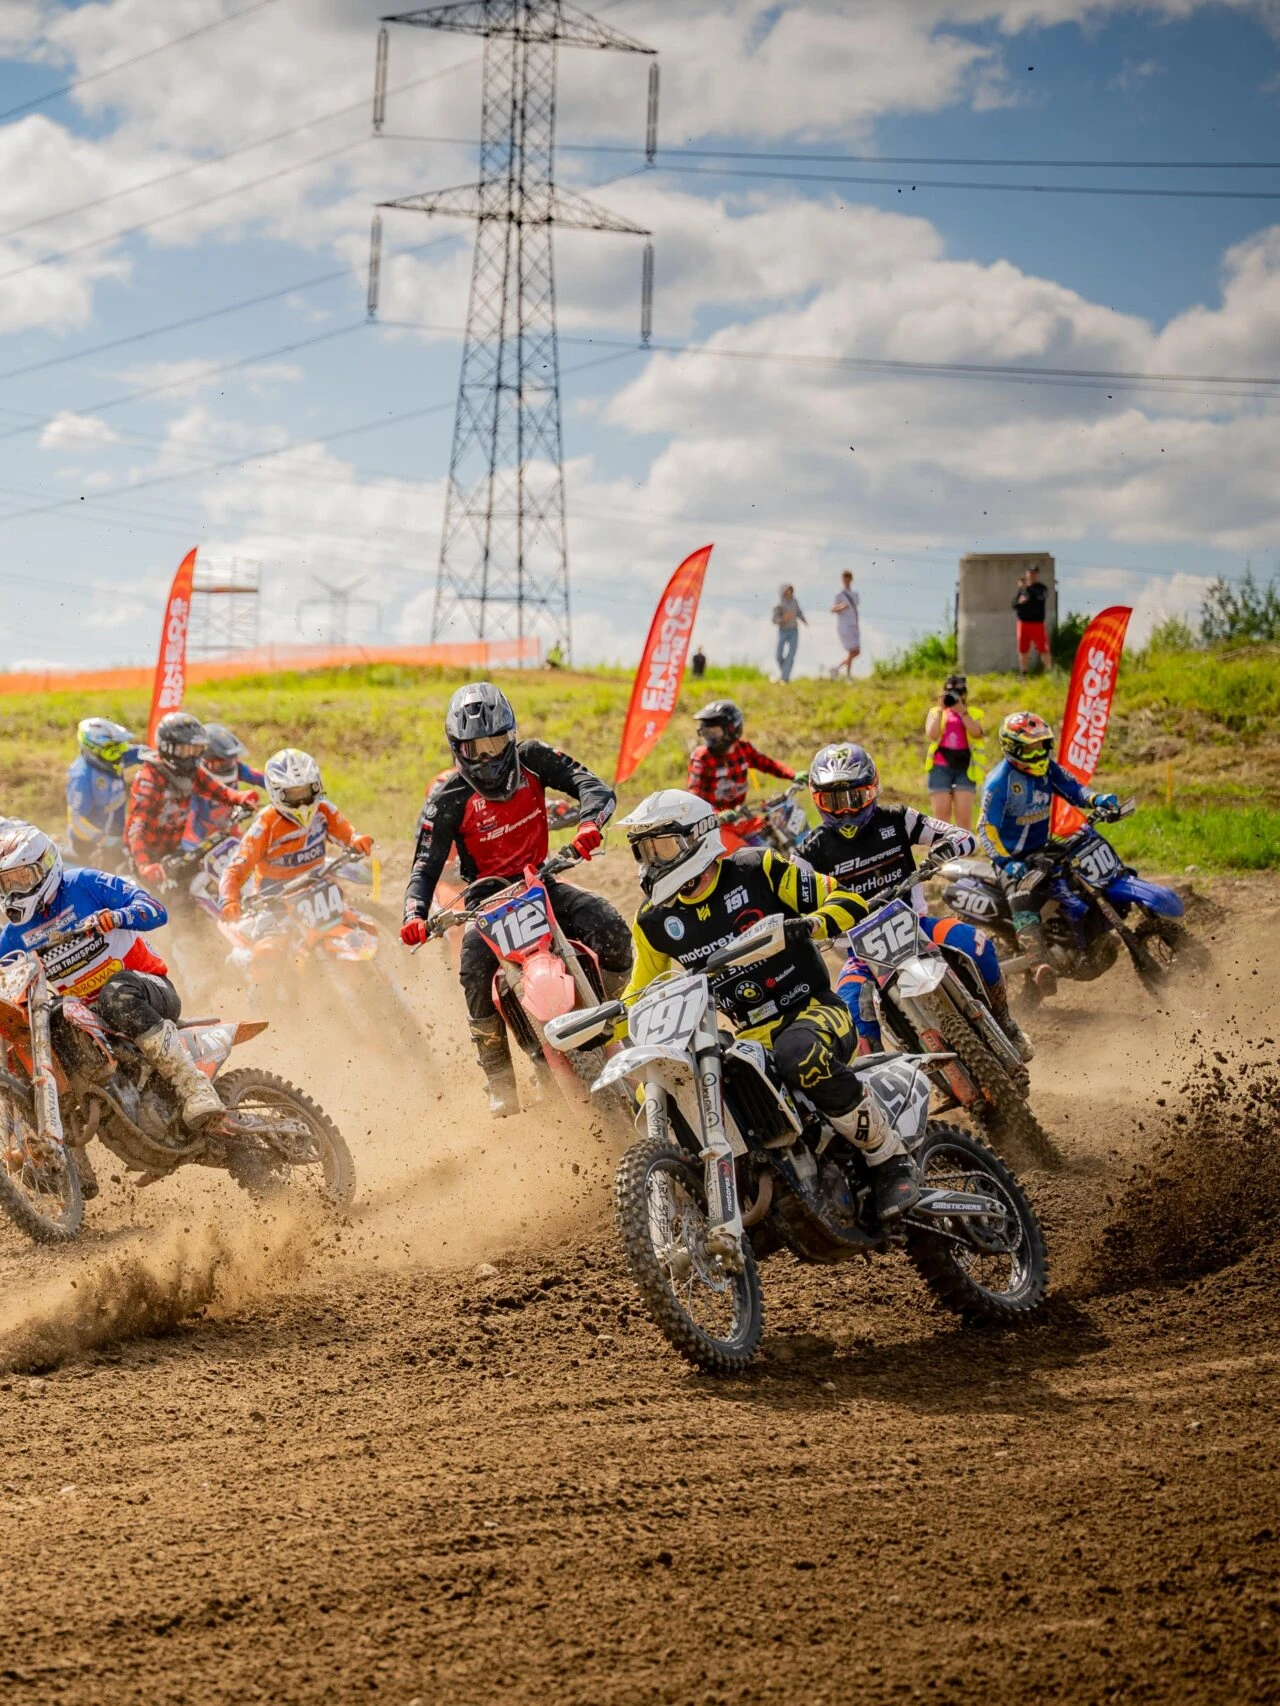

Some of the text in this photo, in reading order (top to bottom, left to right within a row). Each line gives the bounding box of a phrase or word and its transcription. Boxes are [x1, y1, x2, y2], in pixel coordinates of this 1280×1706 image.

[641, 596, 682, 711] ENEOS
[1068, 646, 1105, 770] ENEOS
[1083, 697, 1109, 774] MOTOR
[881, 828, 896, 840] 512
[846, 867, 903, 895] derHouse
[1081, 843, 1117, 882] 310
[297, 885, 343, 929] 344
[725, 890, 750, 914] 191
[801, 886, 810, 904] ART
[951, 889, 991, 915] 310
[491, 900, 550, 957] 112
[678, 931, 738, 964] motorex
[862, 910, 916, 962] 512
[63, 937, 105, 967] TRANSPORT
[635, 988, 703, 1047] 191
[724, 1176, 734, 1213] motorex
